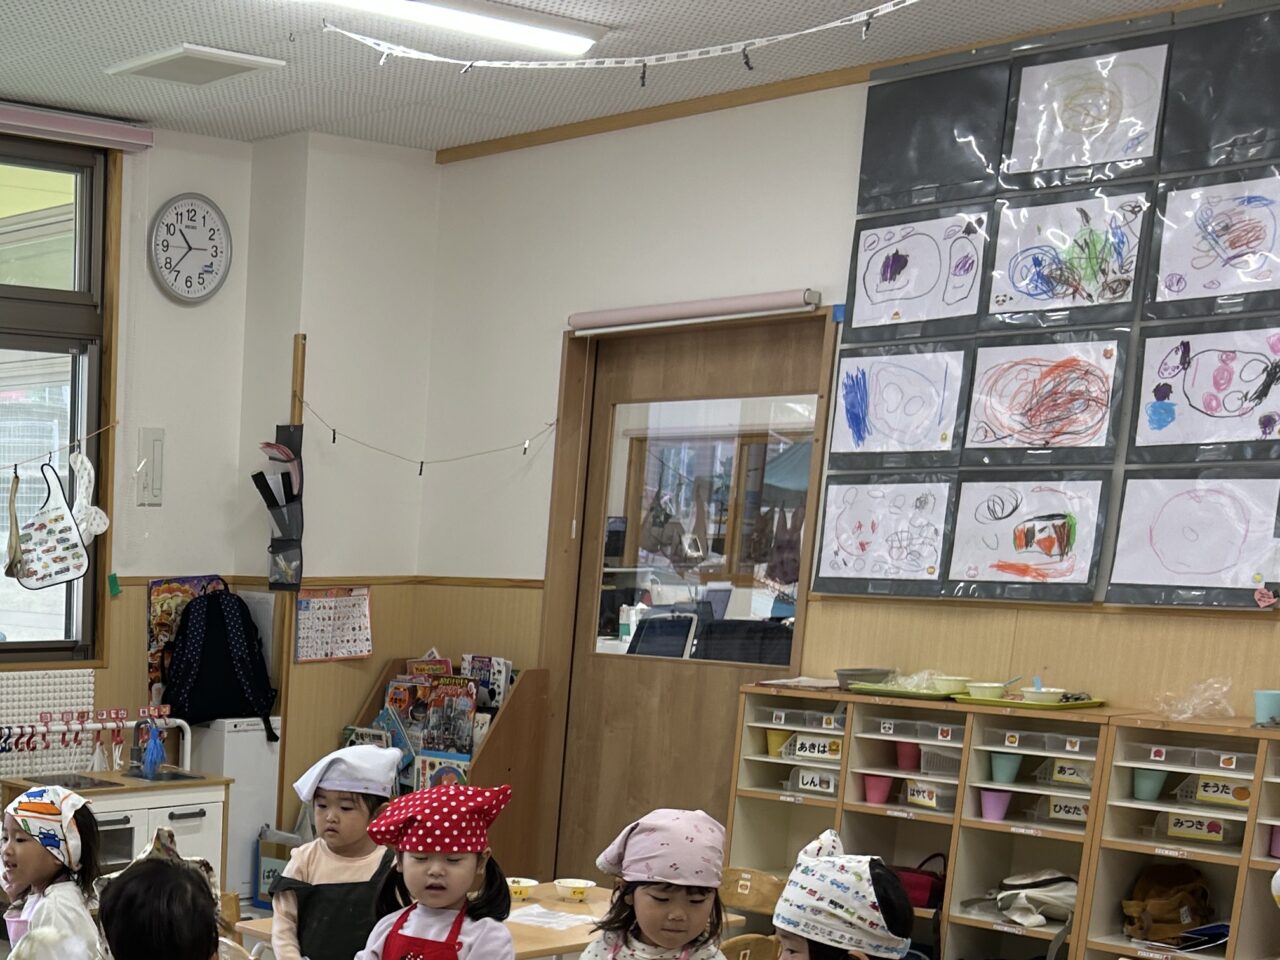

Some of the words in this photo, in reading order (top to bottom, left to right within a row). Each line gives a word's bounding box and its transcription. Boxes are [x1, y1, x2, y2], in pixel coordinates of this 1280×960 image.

[175, 211, 183, 225] 11
[186, 208, 197, 222] 12
[202, 214, 206, 228] 1
[165, 223, 176, 236] 10
[208, 228, 216, 241] 2
[161, 239, 169, 252] 9
[211, 245, 218, 258] 3
[164, 257, 172, 270] 8
[174, 270, 181, 283] 7
[185, 275, 193, 289] 6
[197, 272, 205, 286] 5
[797, 742, 828, 755] あきは
[1057, 766, 1081, 777] あつ
[801, 775, 818, 787] しん
[909, 788, 926, 799] はやて
[1201, 782, 1231, 795] そうた
[1053, 803, 1082, 815] ひなた
[1173, 818, 1205, 831] みつき
